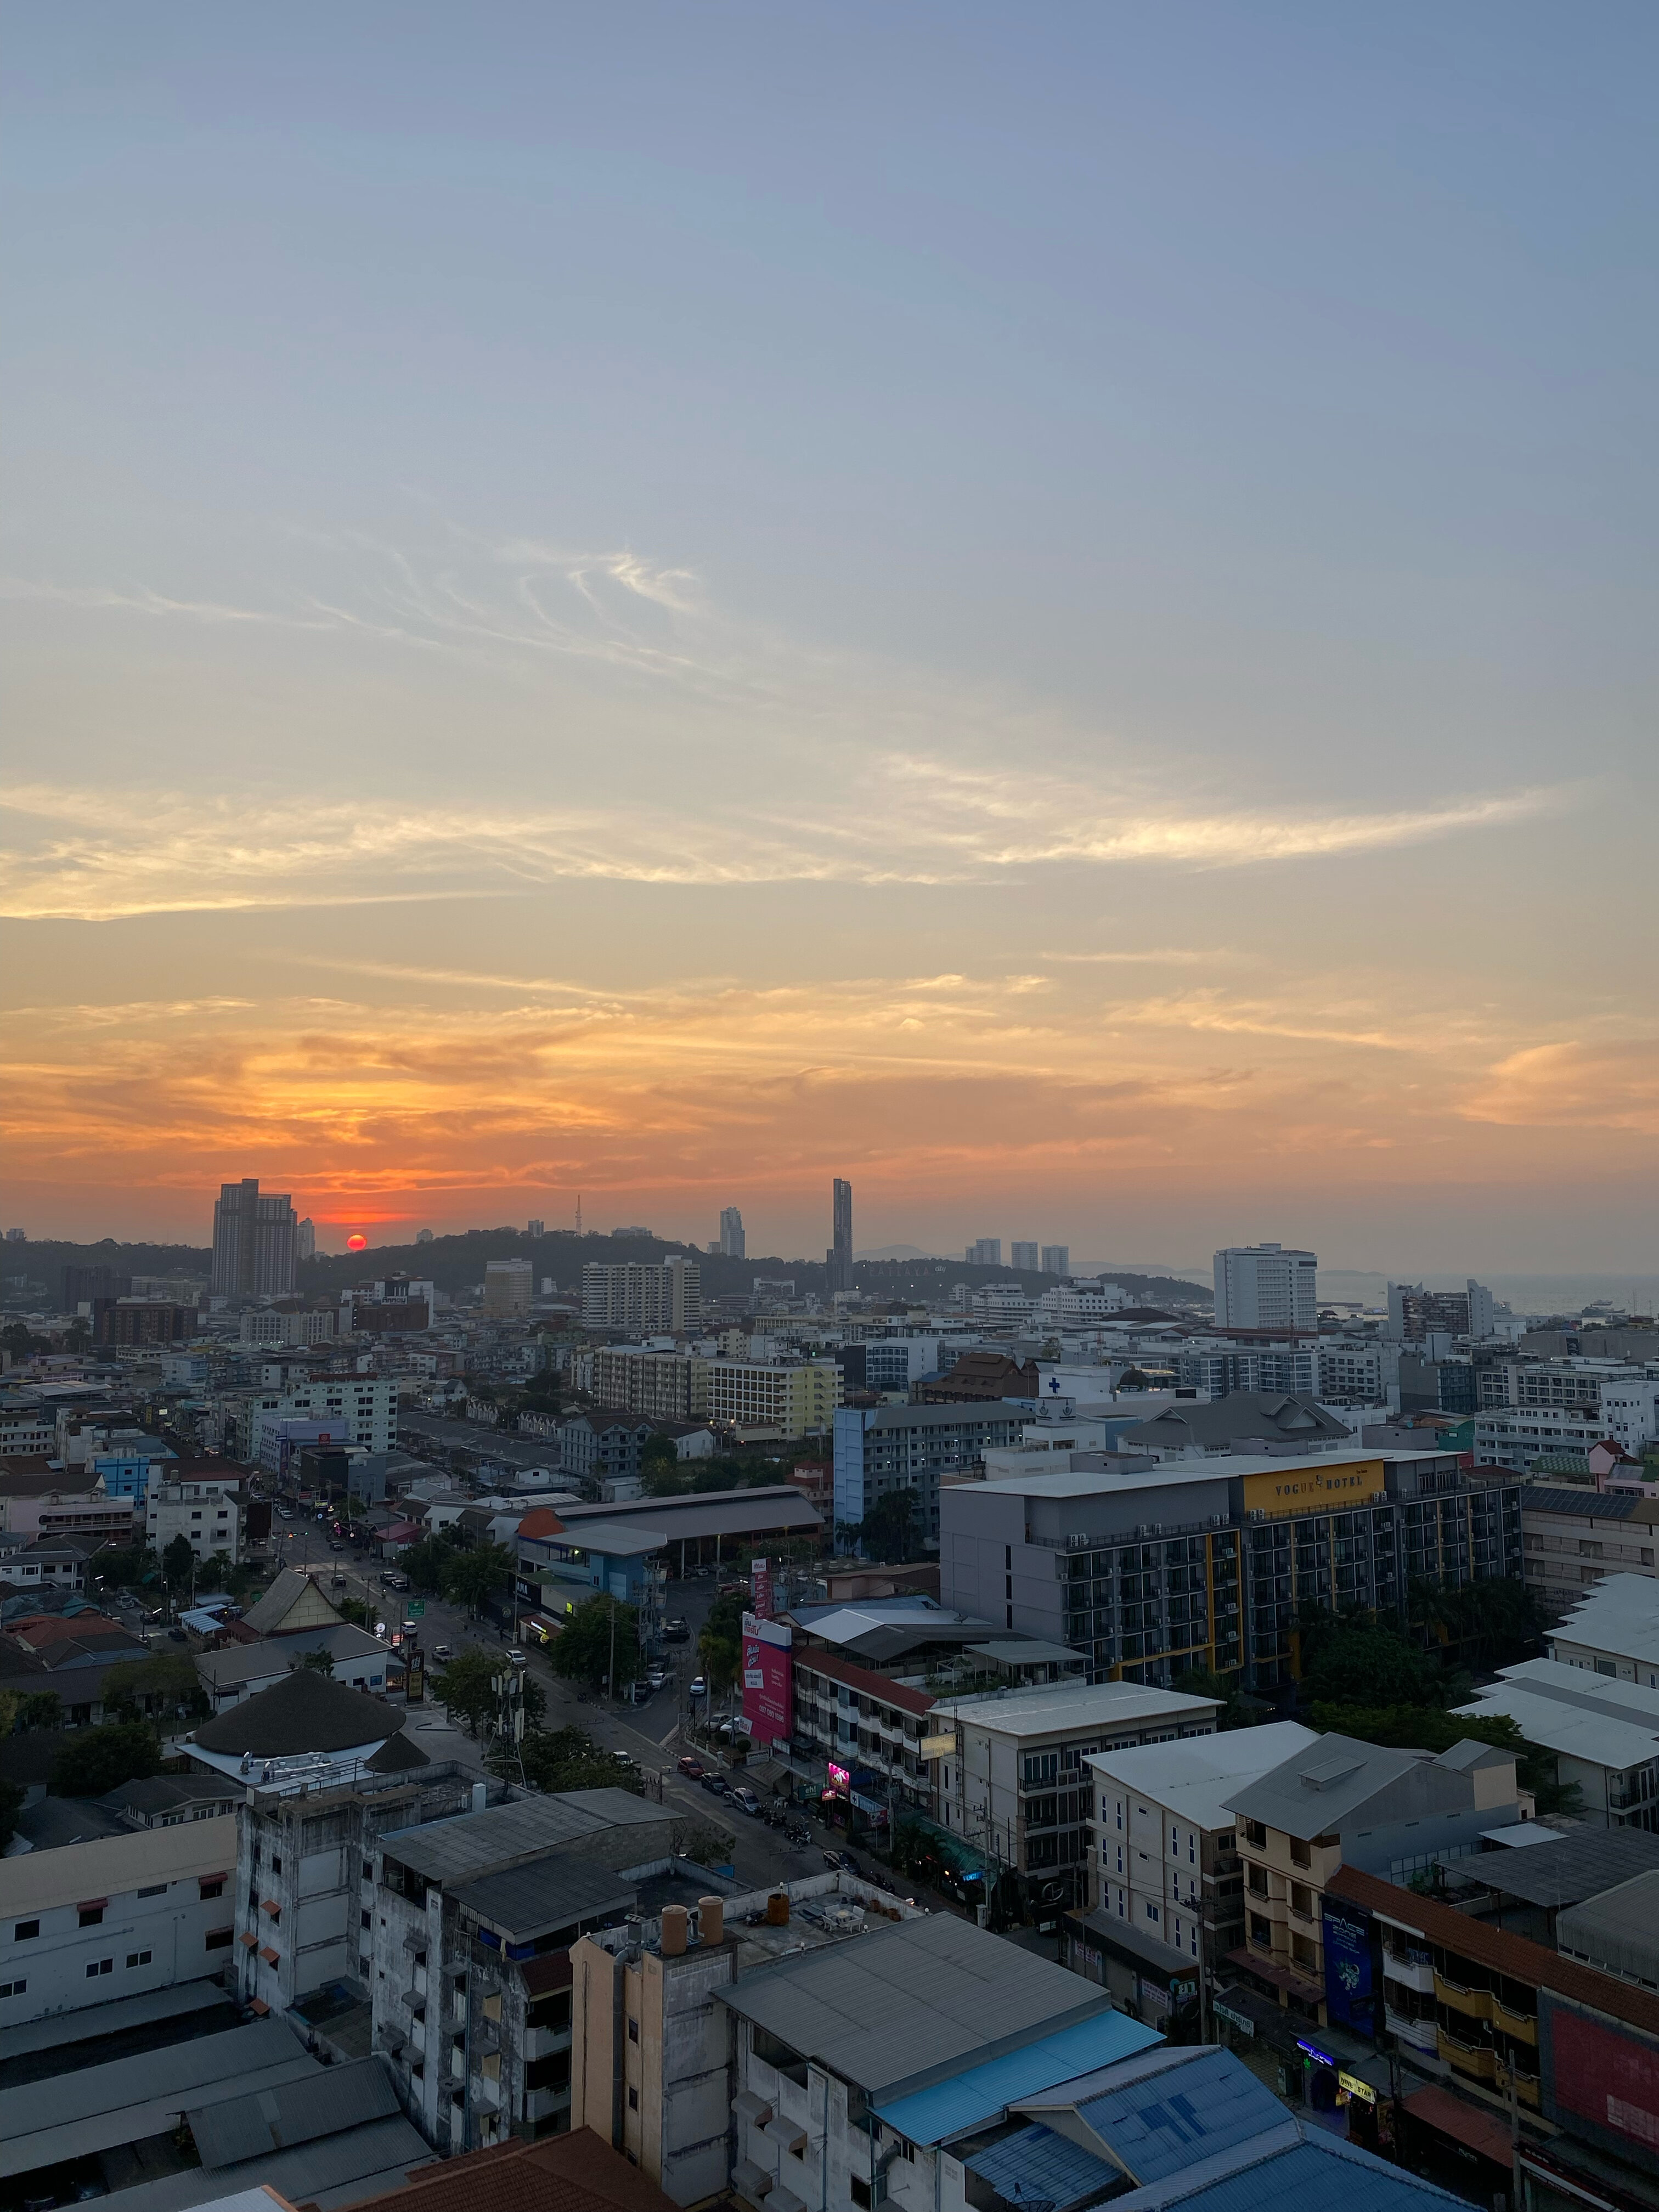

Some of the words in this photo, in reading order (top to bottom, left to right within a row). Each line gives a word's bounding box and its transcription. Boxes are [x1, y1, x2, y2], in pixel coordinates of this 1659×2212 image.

[869, 1266, 931, 1277] PATTAYA
[1276, 1482, 1314, 1496] VOGUE
[1327, 1476, 1362, 1489] HOTEL
[1324, 1912, 1365, 1937] SPACE
[1340, 2076, 1353, 2089] NINE
[1357, 2086, 1371, 2099] STAR
